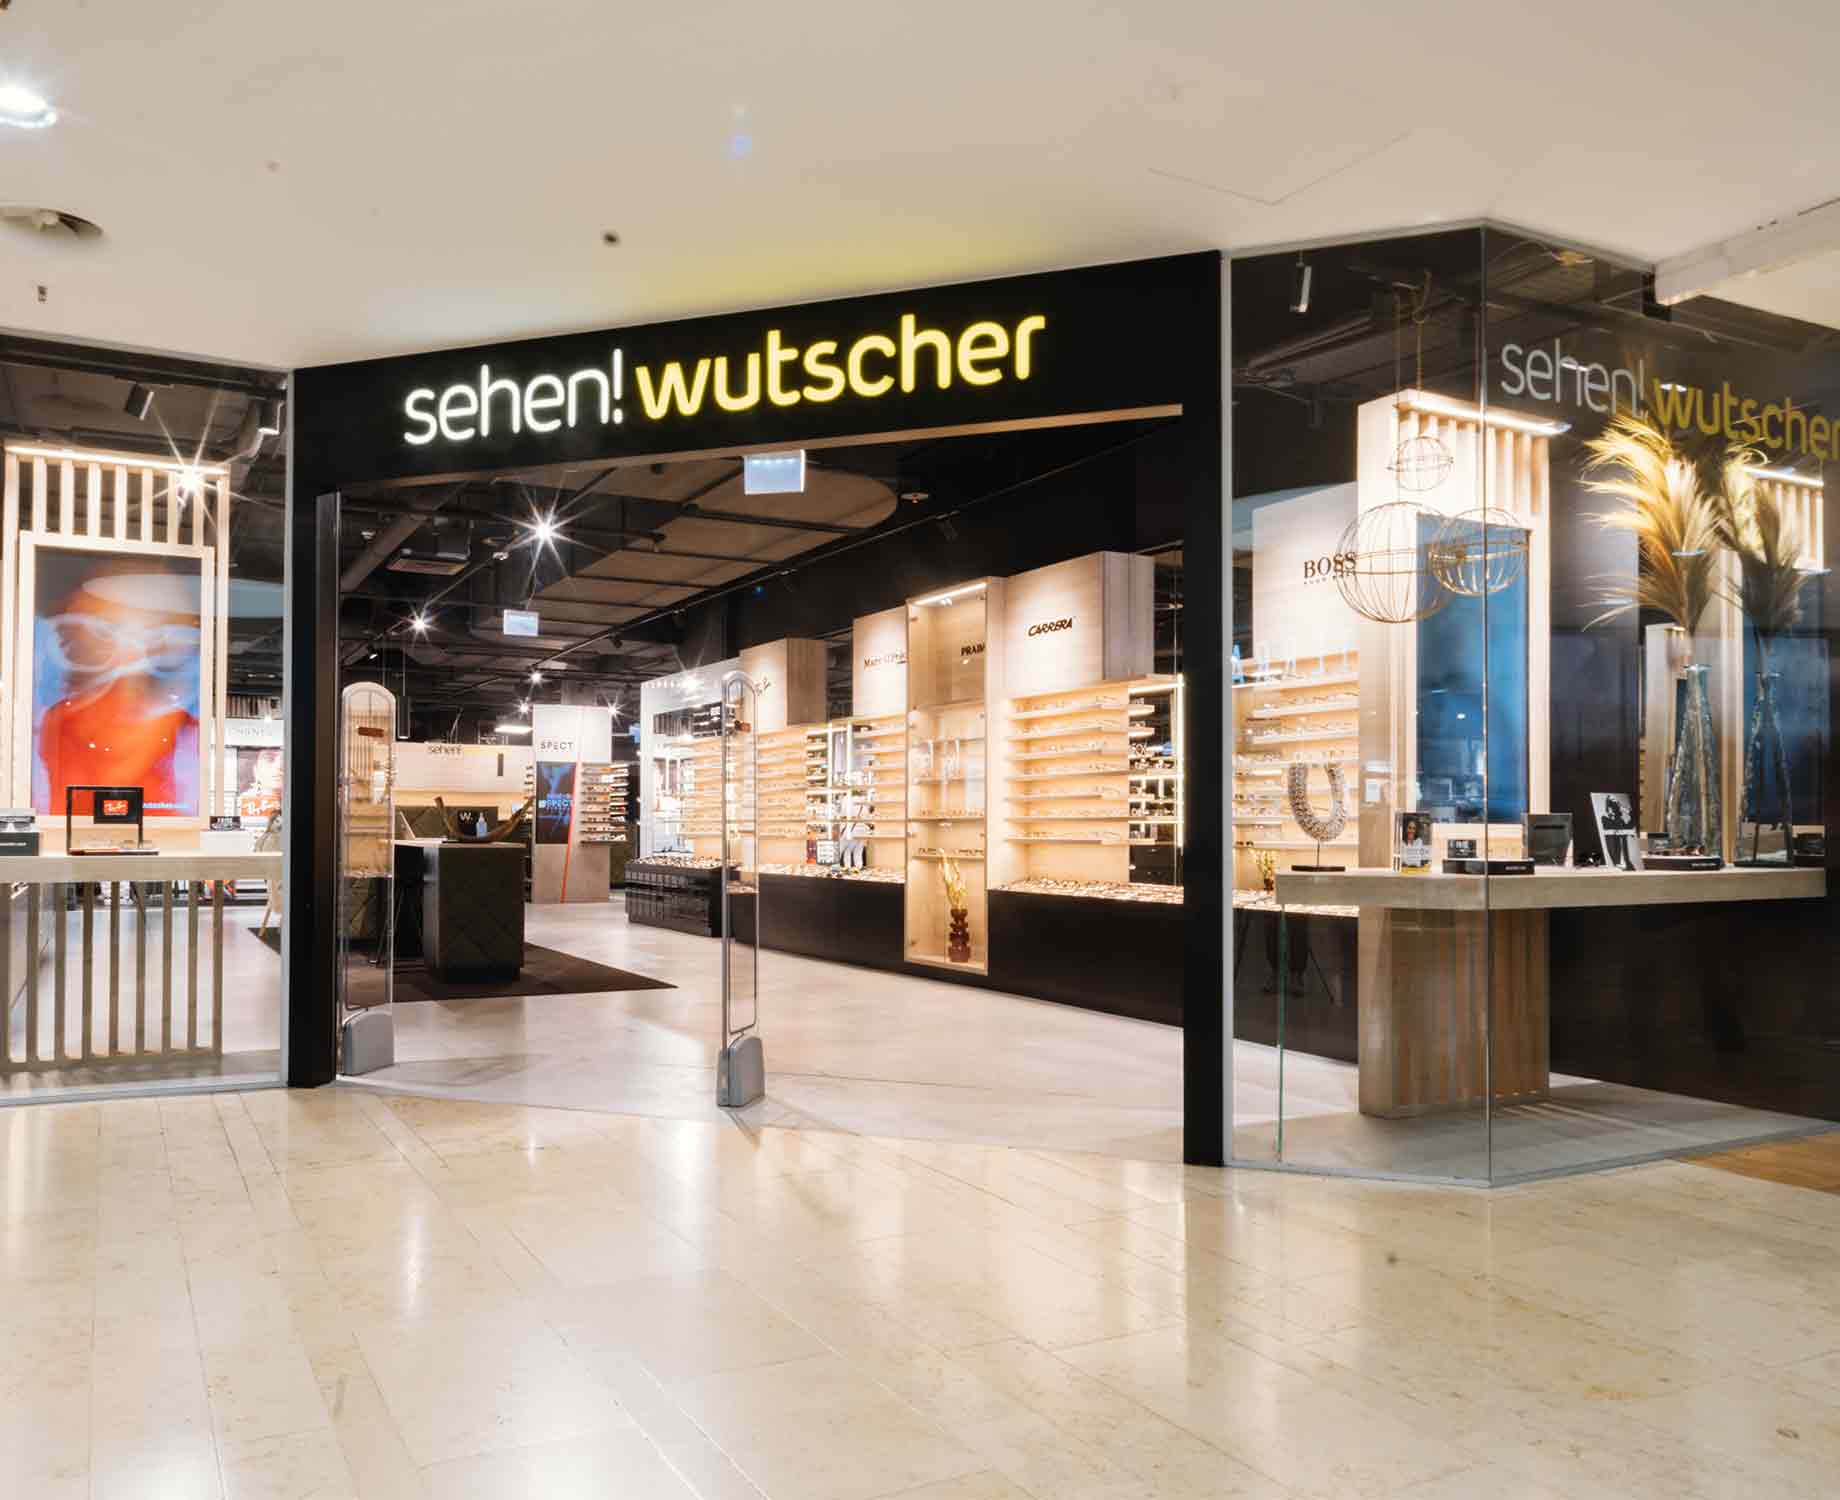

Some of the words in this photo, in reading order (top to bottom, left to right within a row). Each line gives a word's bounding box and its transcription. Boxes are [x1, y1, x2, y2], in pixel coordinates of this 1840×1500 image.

[402, 347, 624, 446] sehen!
[635, 313, 1046, 420] wutscher
[1500, 338, 1649, 423] sehen!
[1303, 551, 1357, 579] BOSS
[1027, 616, 1073, 637] CARRERA
[960, 641, 986, 656] PRAD
[540, 741, 575, 751] SPECT
